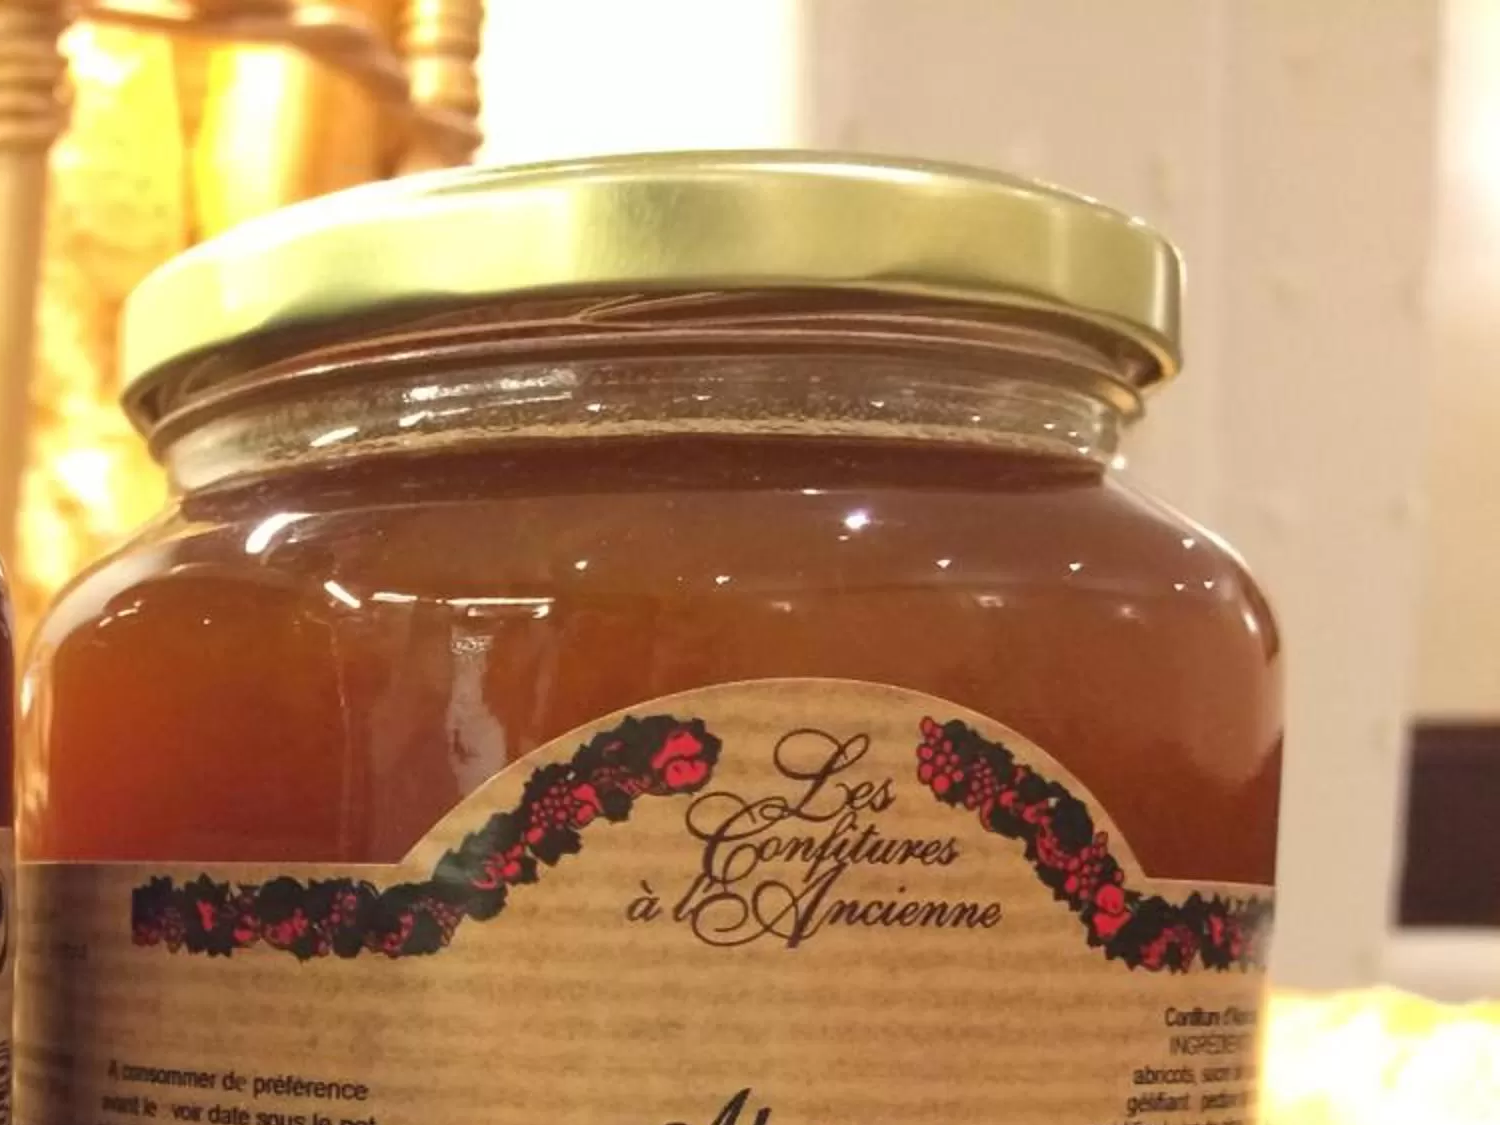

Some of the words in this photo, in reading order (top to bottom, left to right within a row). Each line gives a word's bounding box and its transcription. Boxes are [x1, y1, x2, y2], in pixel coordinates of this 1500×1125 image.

[774, 728, 897, 822] Les
[685, 791, 960, 884] Confitures
[626, 880, 662, 922] à
[222, 1071, 247, 1092] de
[253, 1073, 369, 1101] préférence
[172, 1103, 201, 1121] voir
